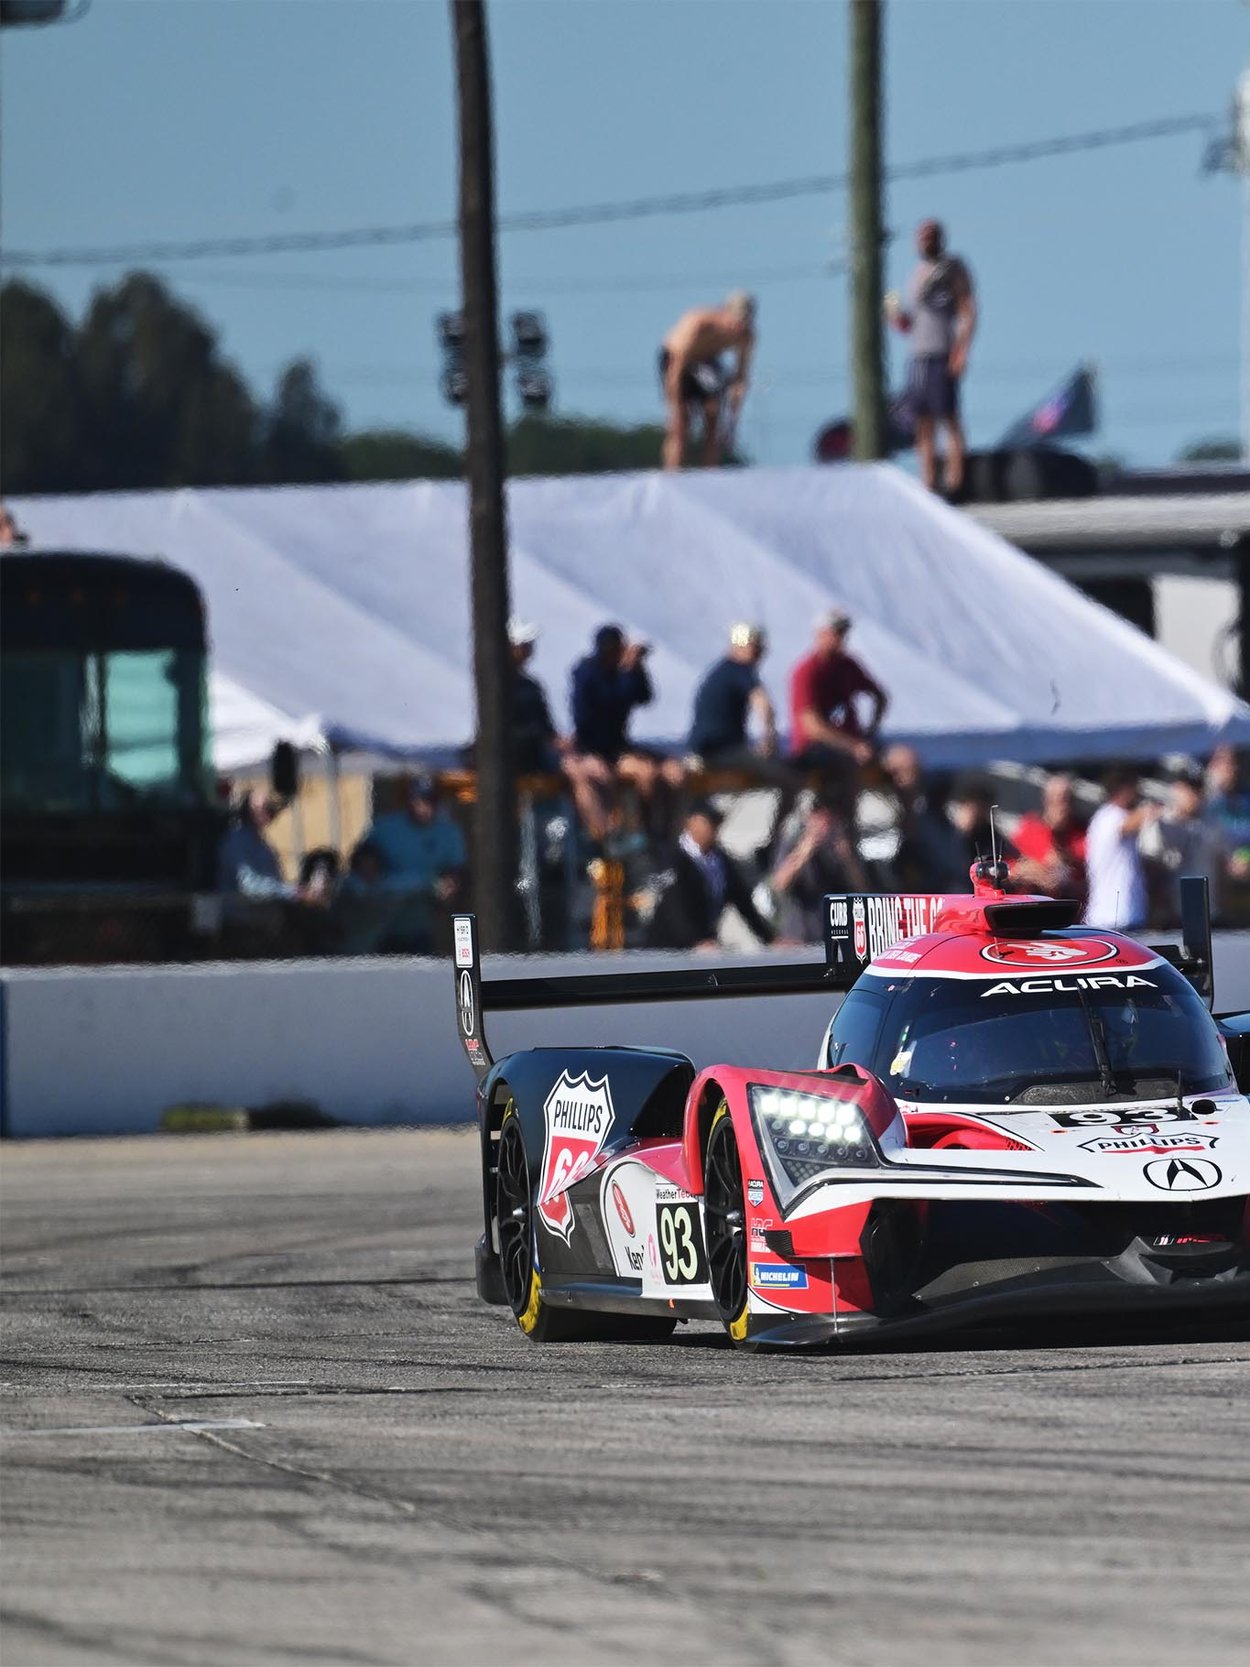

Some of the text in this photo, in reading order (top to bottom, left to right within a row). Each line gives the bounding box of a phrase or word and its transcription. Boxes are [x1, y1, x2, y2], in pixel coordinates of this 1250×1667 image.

[830, 902, 848, 927] CURB
[980, 975, 1158, 997] ACURA
[553, 1100, 603, 1134] PHILLIPS
[1069, 1108, 1179, 1126] 93
[1099, 1137, 1200, 1150] PHILLIPS
[660, 1206, 698, 1281] 93
[760, 1271, 800, 1282] MICHELIN
